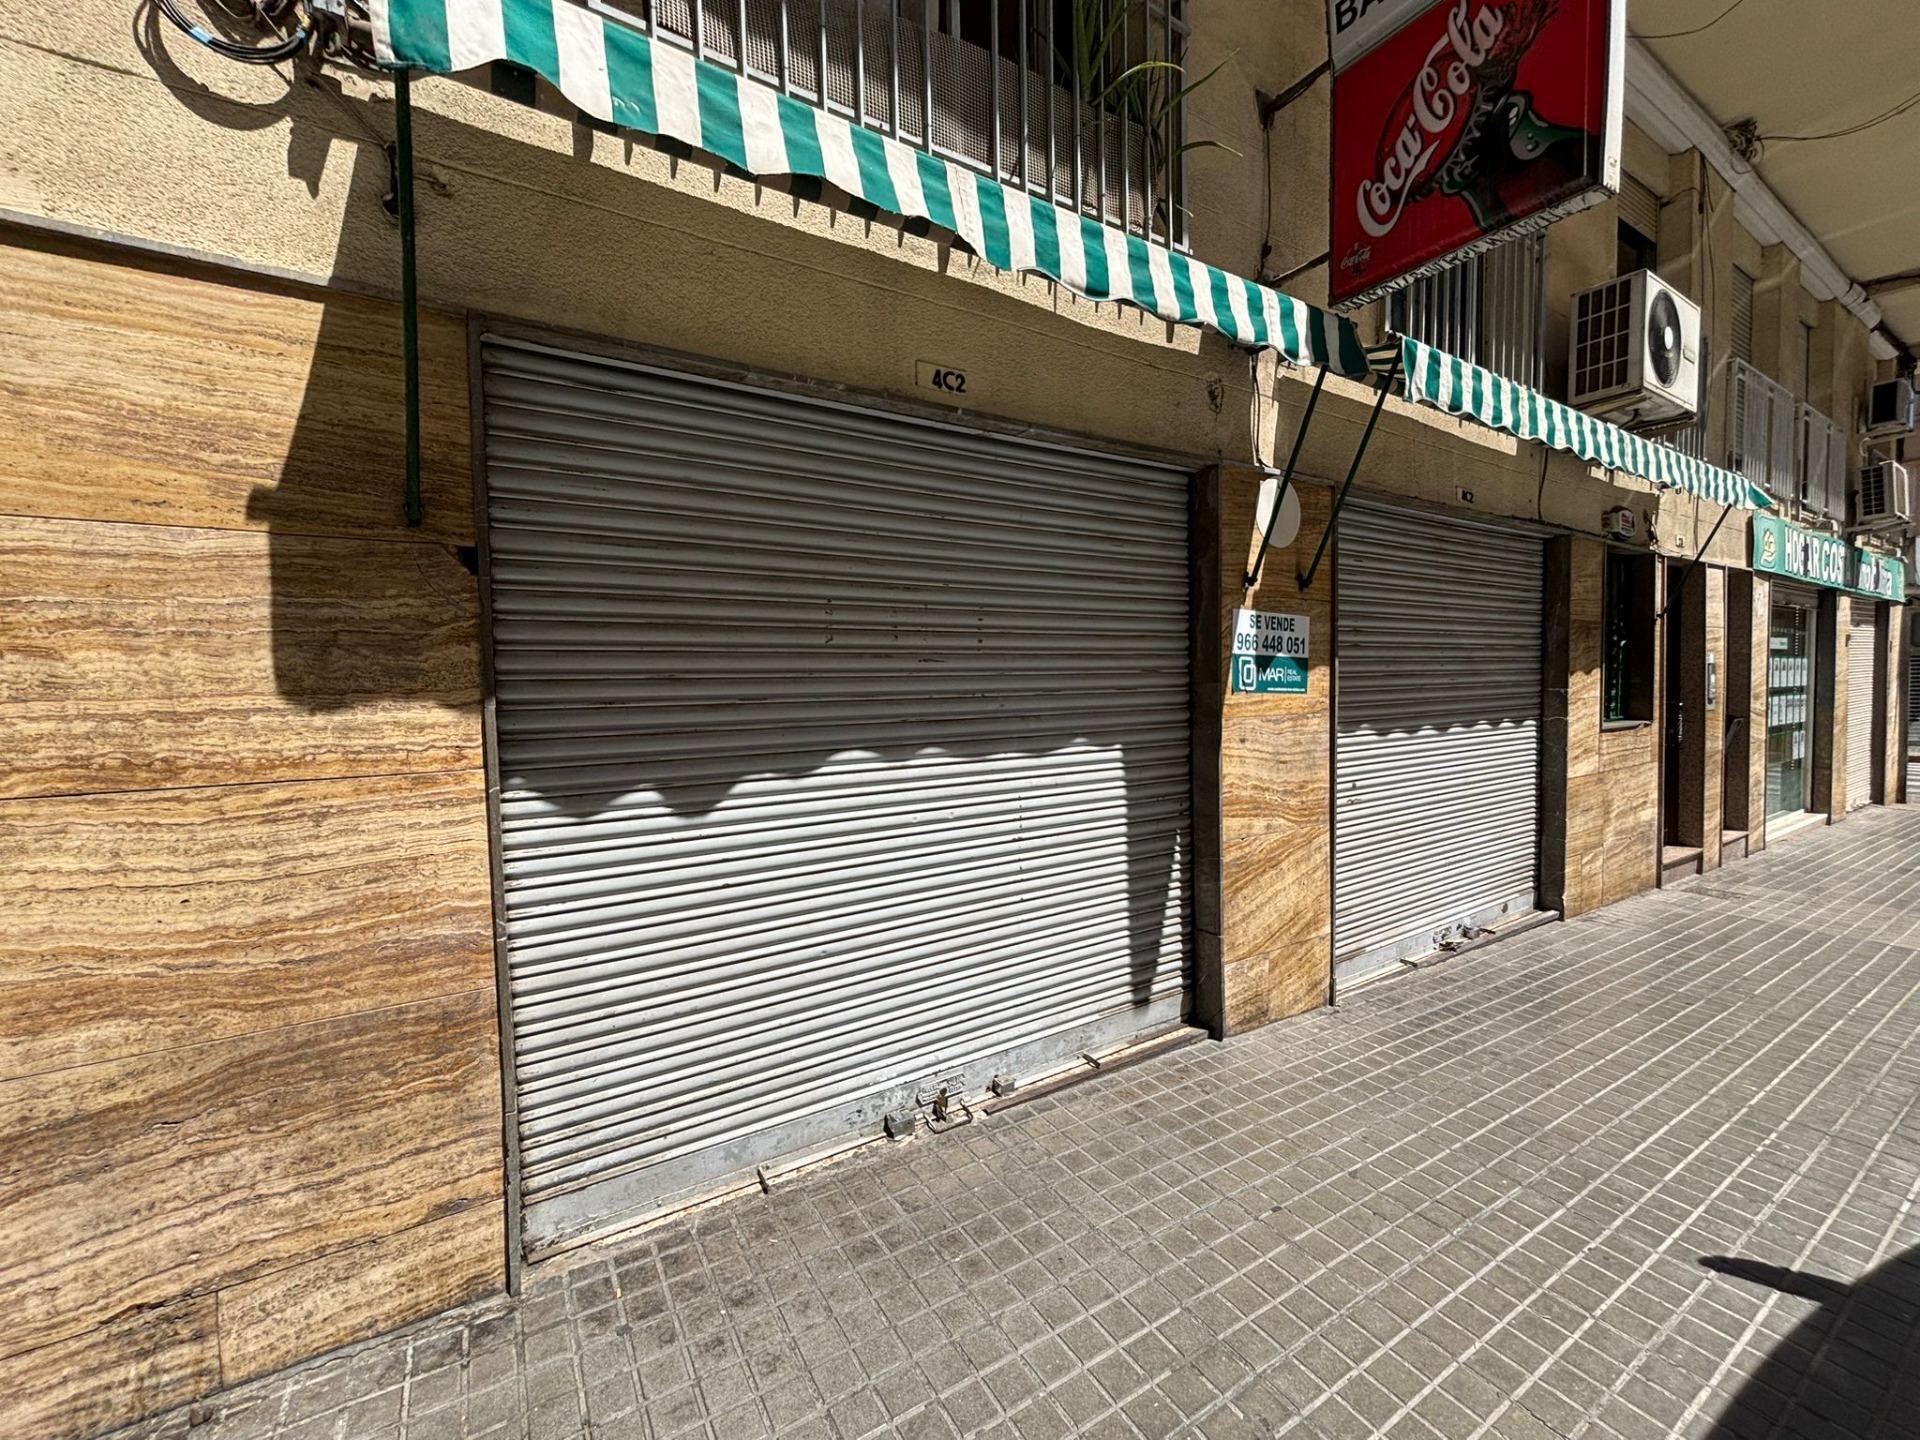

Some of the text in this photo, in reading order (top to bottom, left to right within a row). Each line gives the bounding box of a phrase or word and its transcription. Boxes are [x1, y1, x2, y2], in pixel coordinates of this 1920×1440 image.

[1356, 0, 1503, 237] Coca-Cola
[931, 368, 967, 394] 4C2
[1249, 614, 1295, 632] SE VENDE
[1236, 632, 1305, 654] 966 448 051
